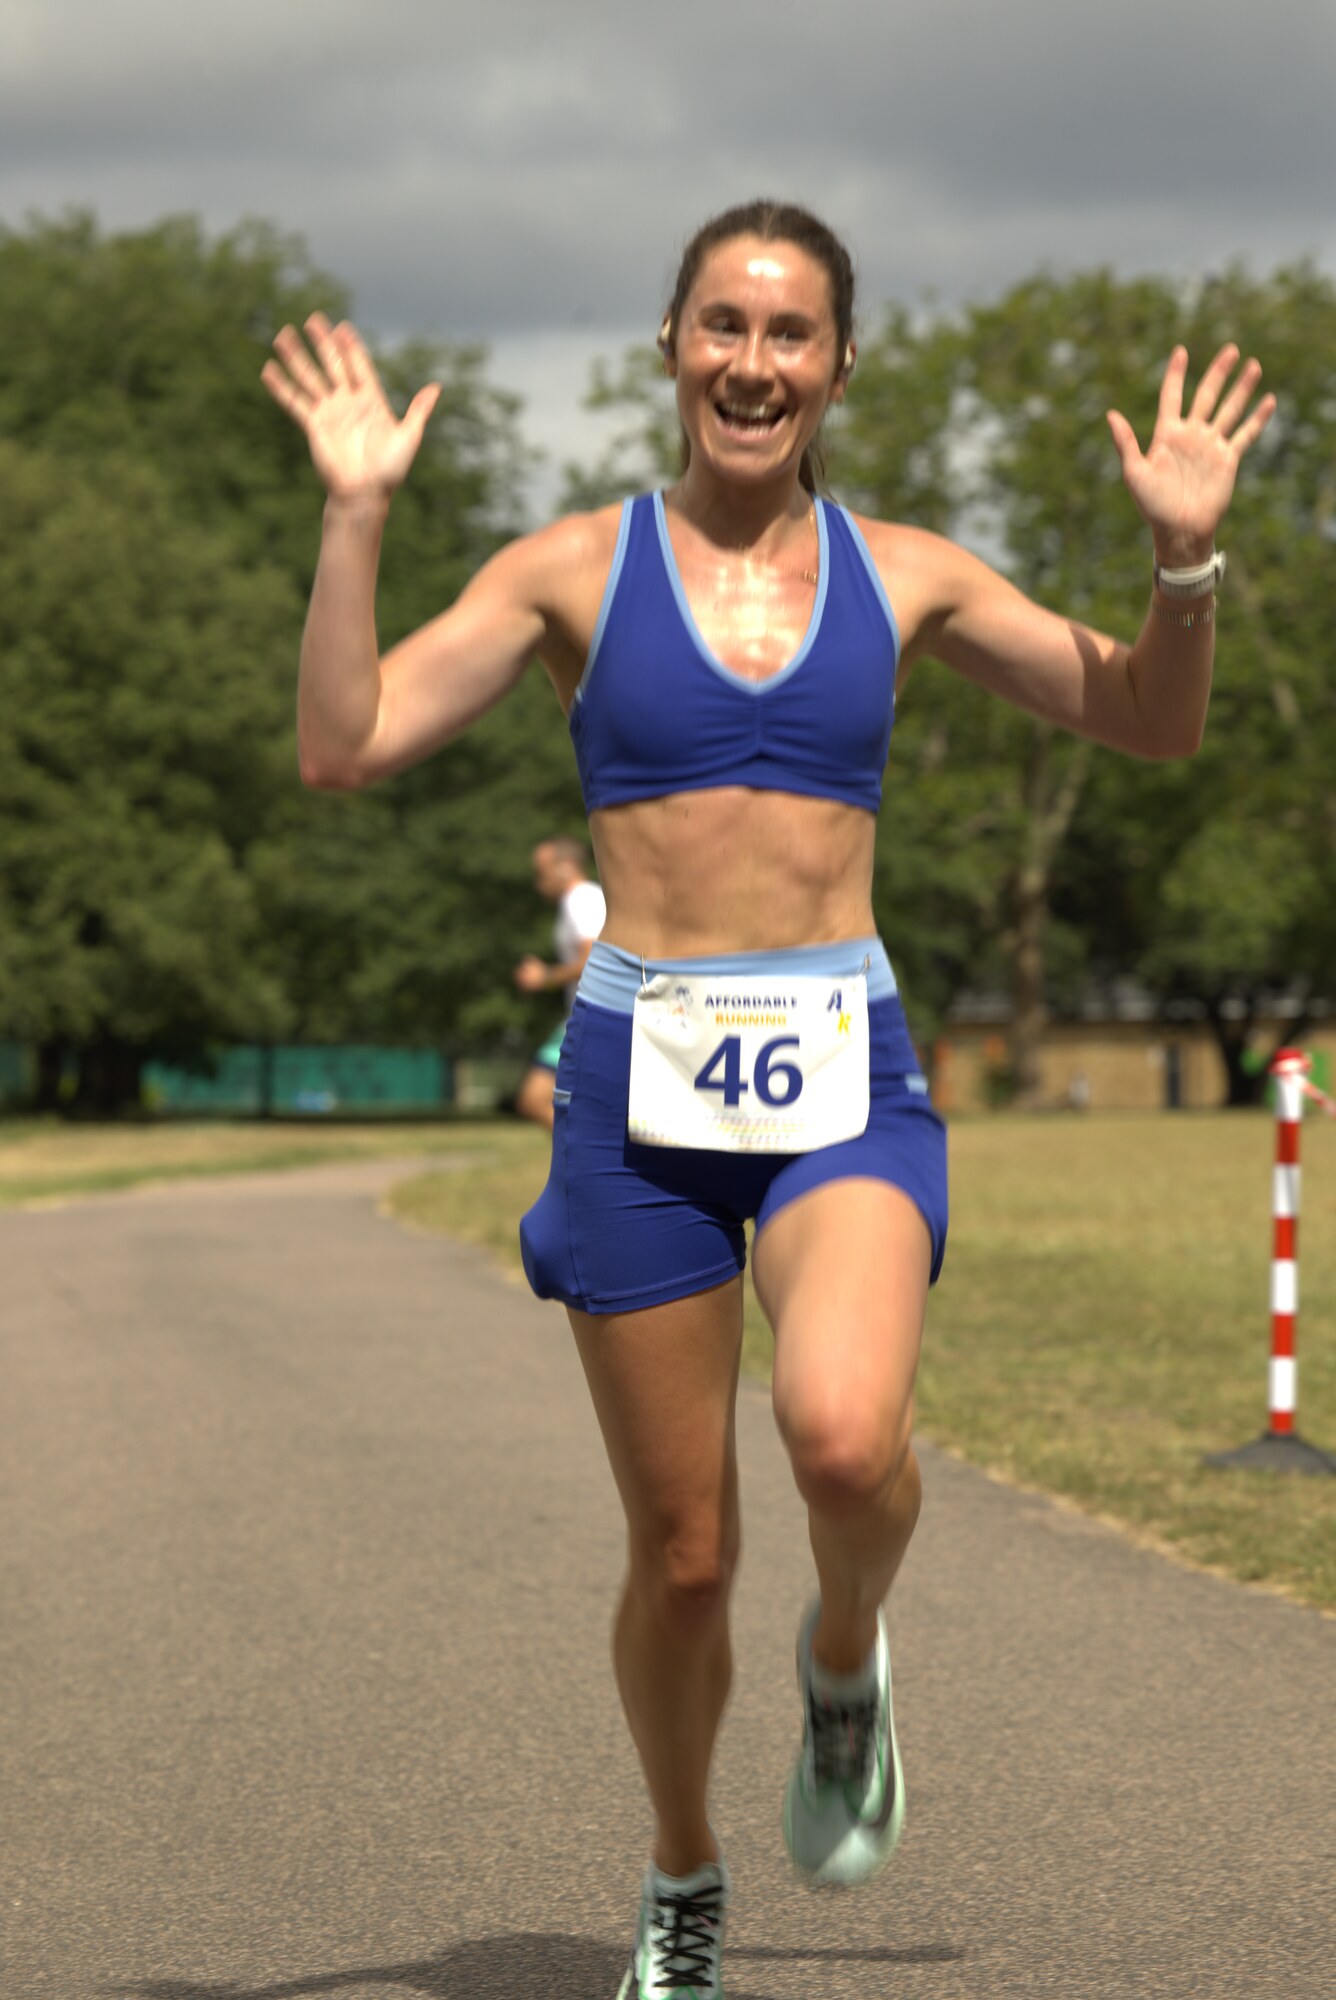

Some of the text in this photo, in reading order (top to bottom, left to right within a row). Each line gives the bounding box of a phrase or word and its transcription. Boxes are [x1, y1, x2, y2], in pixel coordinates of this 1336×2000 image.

[704, 994, 798, 1009] AFFORDABLE
[715, 1012, 787, 1027] RUNNING
[694, 1033, 804, 1109] 46
